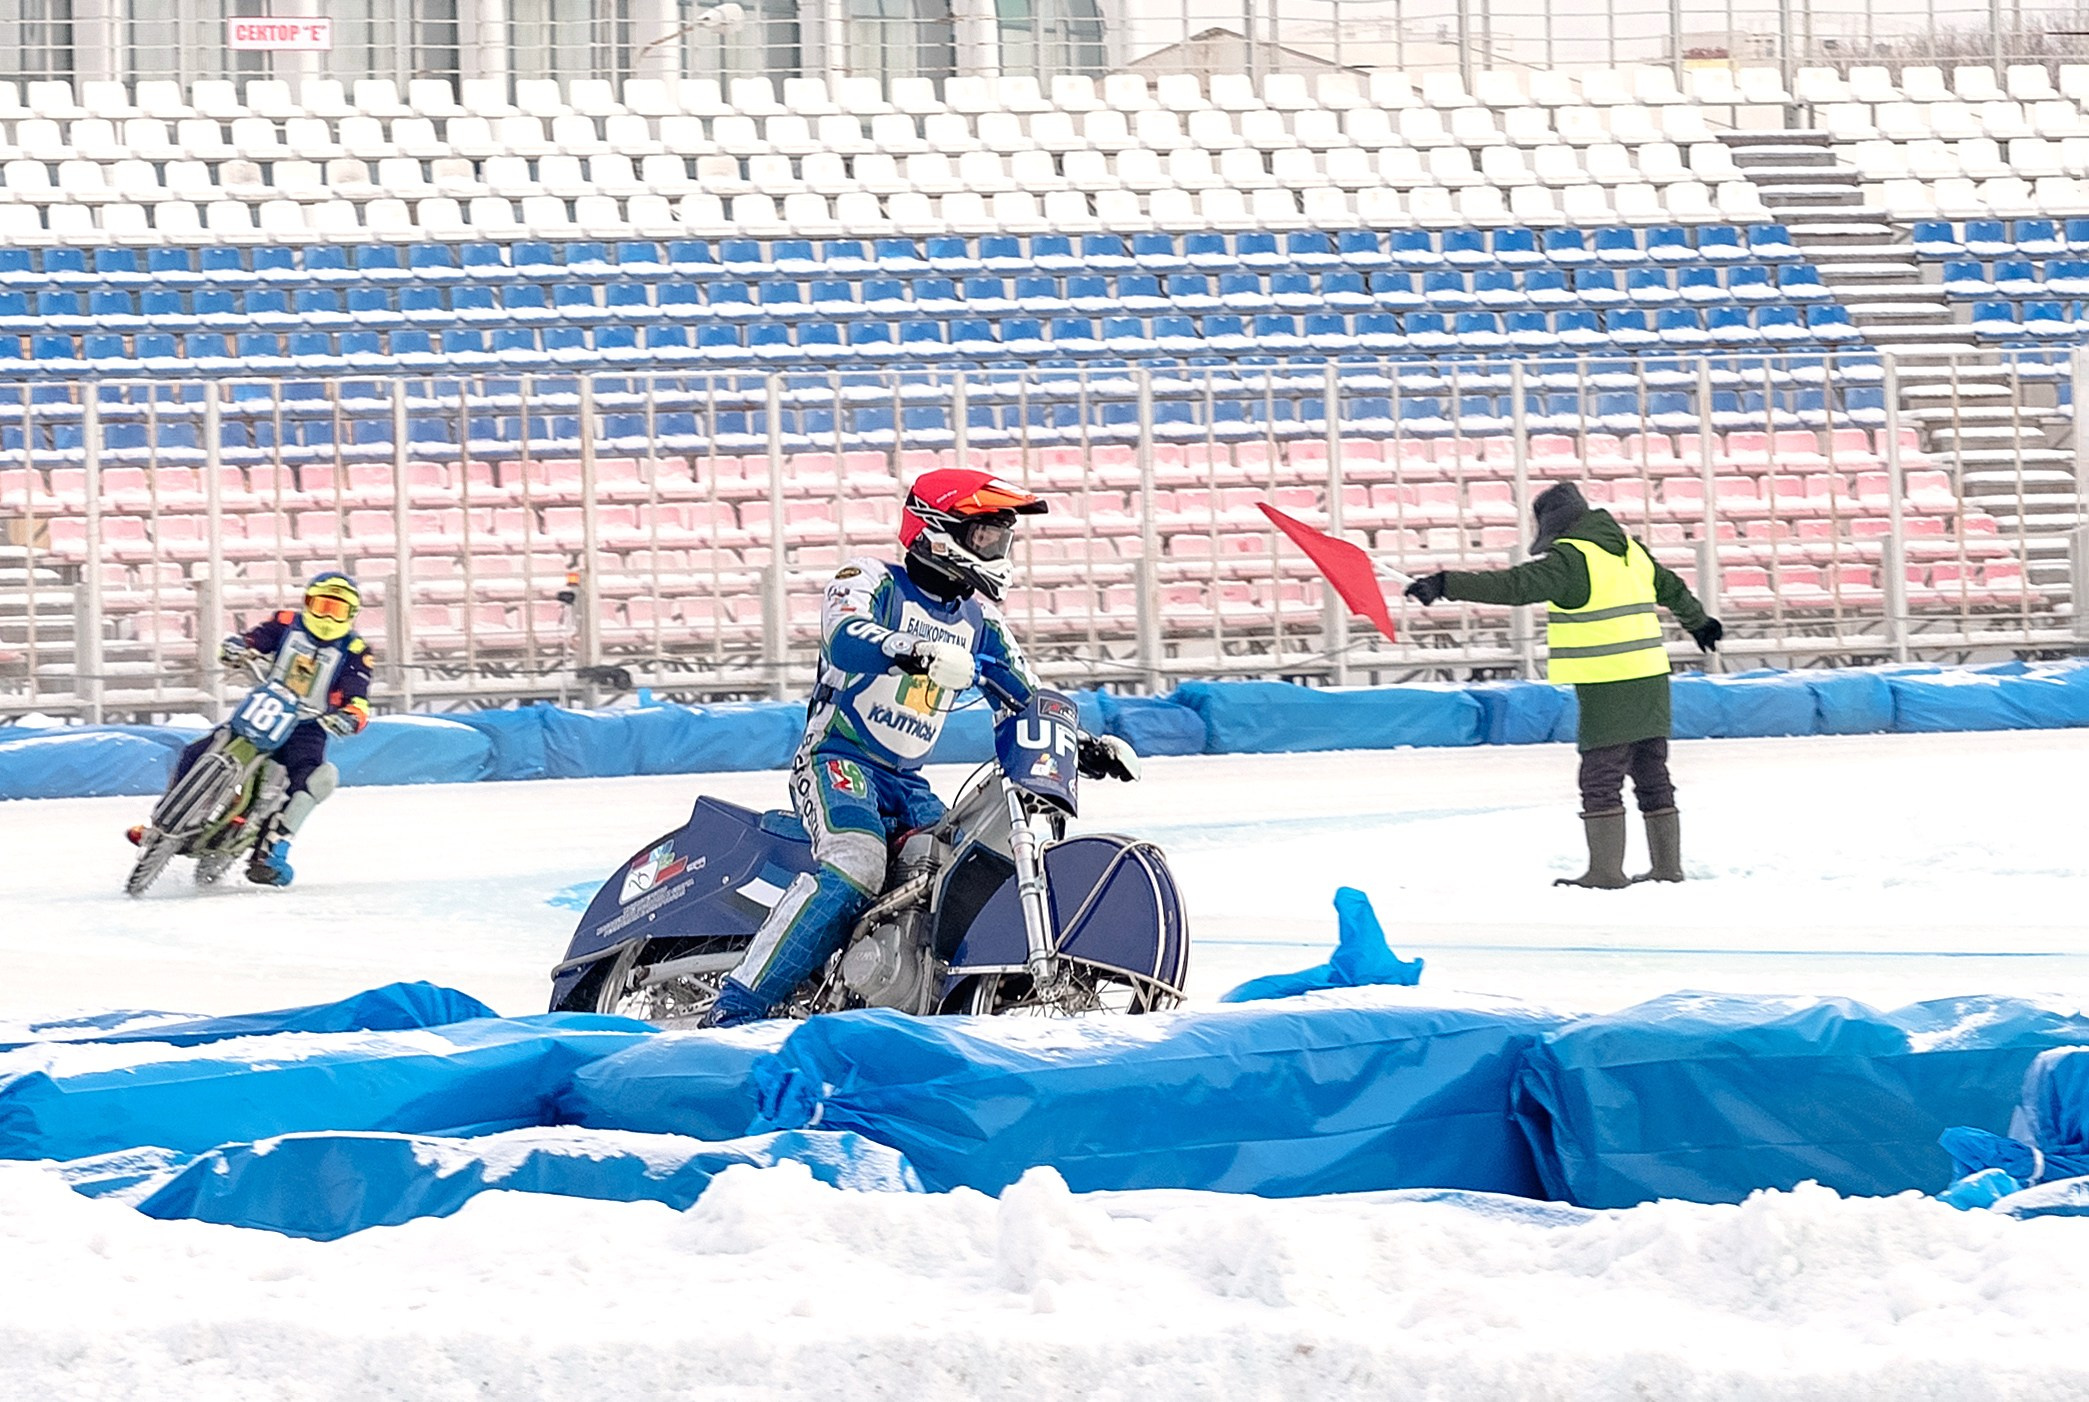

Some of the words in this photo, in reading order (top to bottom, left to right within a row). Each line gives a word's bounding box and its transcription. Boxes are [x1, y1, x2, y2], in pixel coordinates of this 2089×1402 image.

[236, 25, 299, 41] СЕКТОР
[240, 692, 296, 742] 181
[867, 703, 937, 742] КАЛТАСЫ
[1016, 718, 1078, 769] UF
